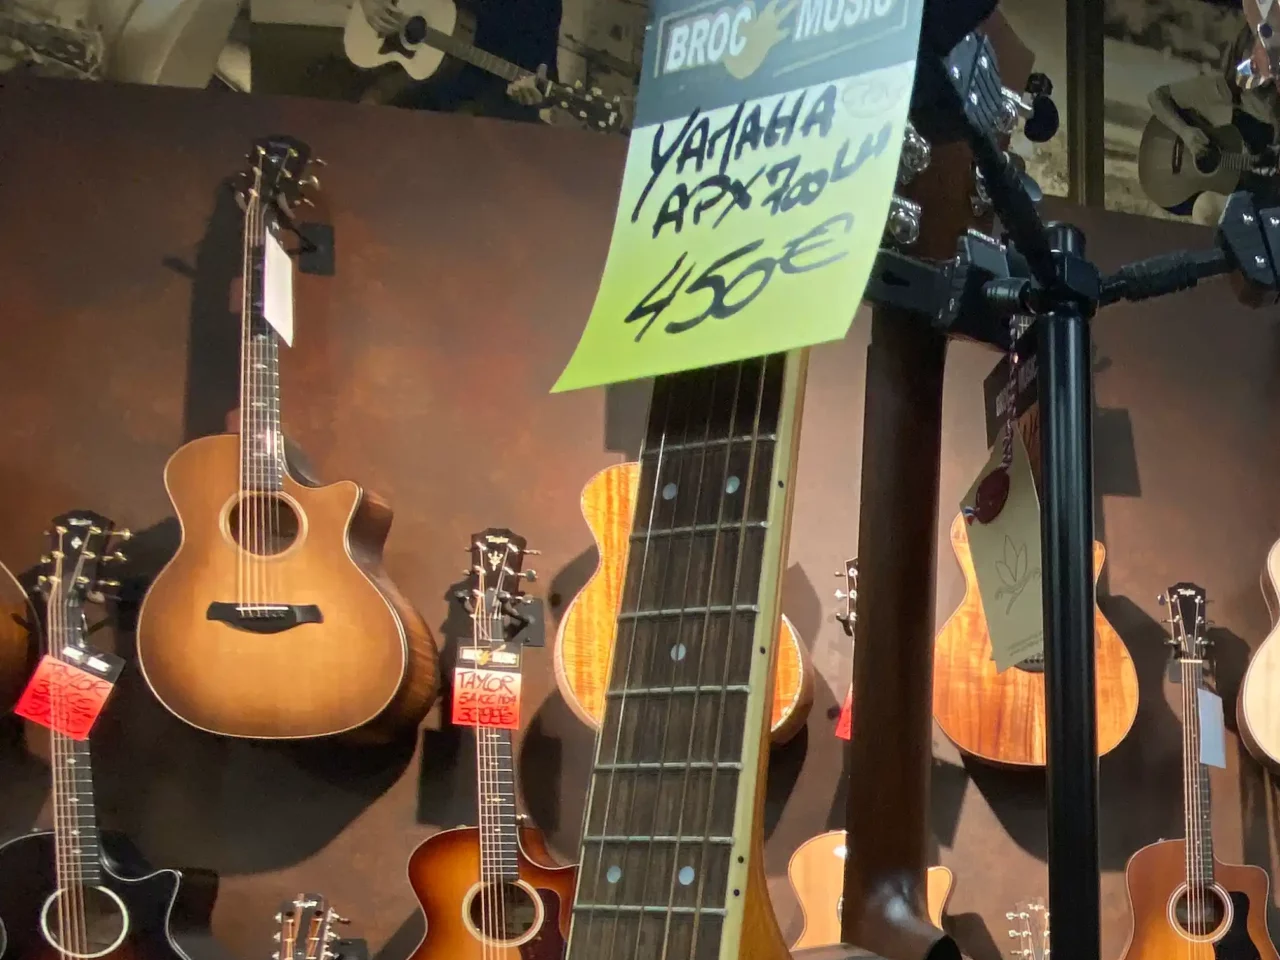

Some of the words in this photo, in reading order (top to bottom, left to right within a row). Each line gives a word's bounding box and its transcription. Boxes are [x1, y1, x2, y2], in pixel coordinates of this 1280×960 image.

[663, 6, 752, 74] BROC
[631, 84, 838, 224] YAMAHA
[457, 670, 515, 695] TAYLOR
